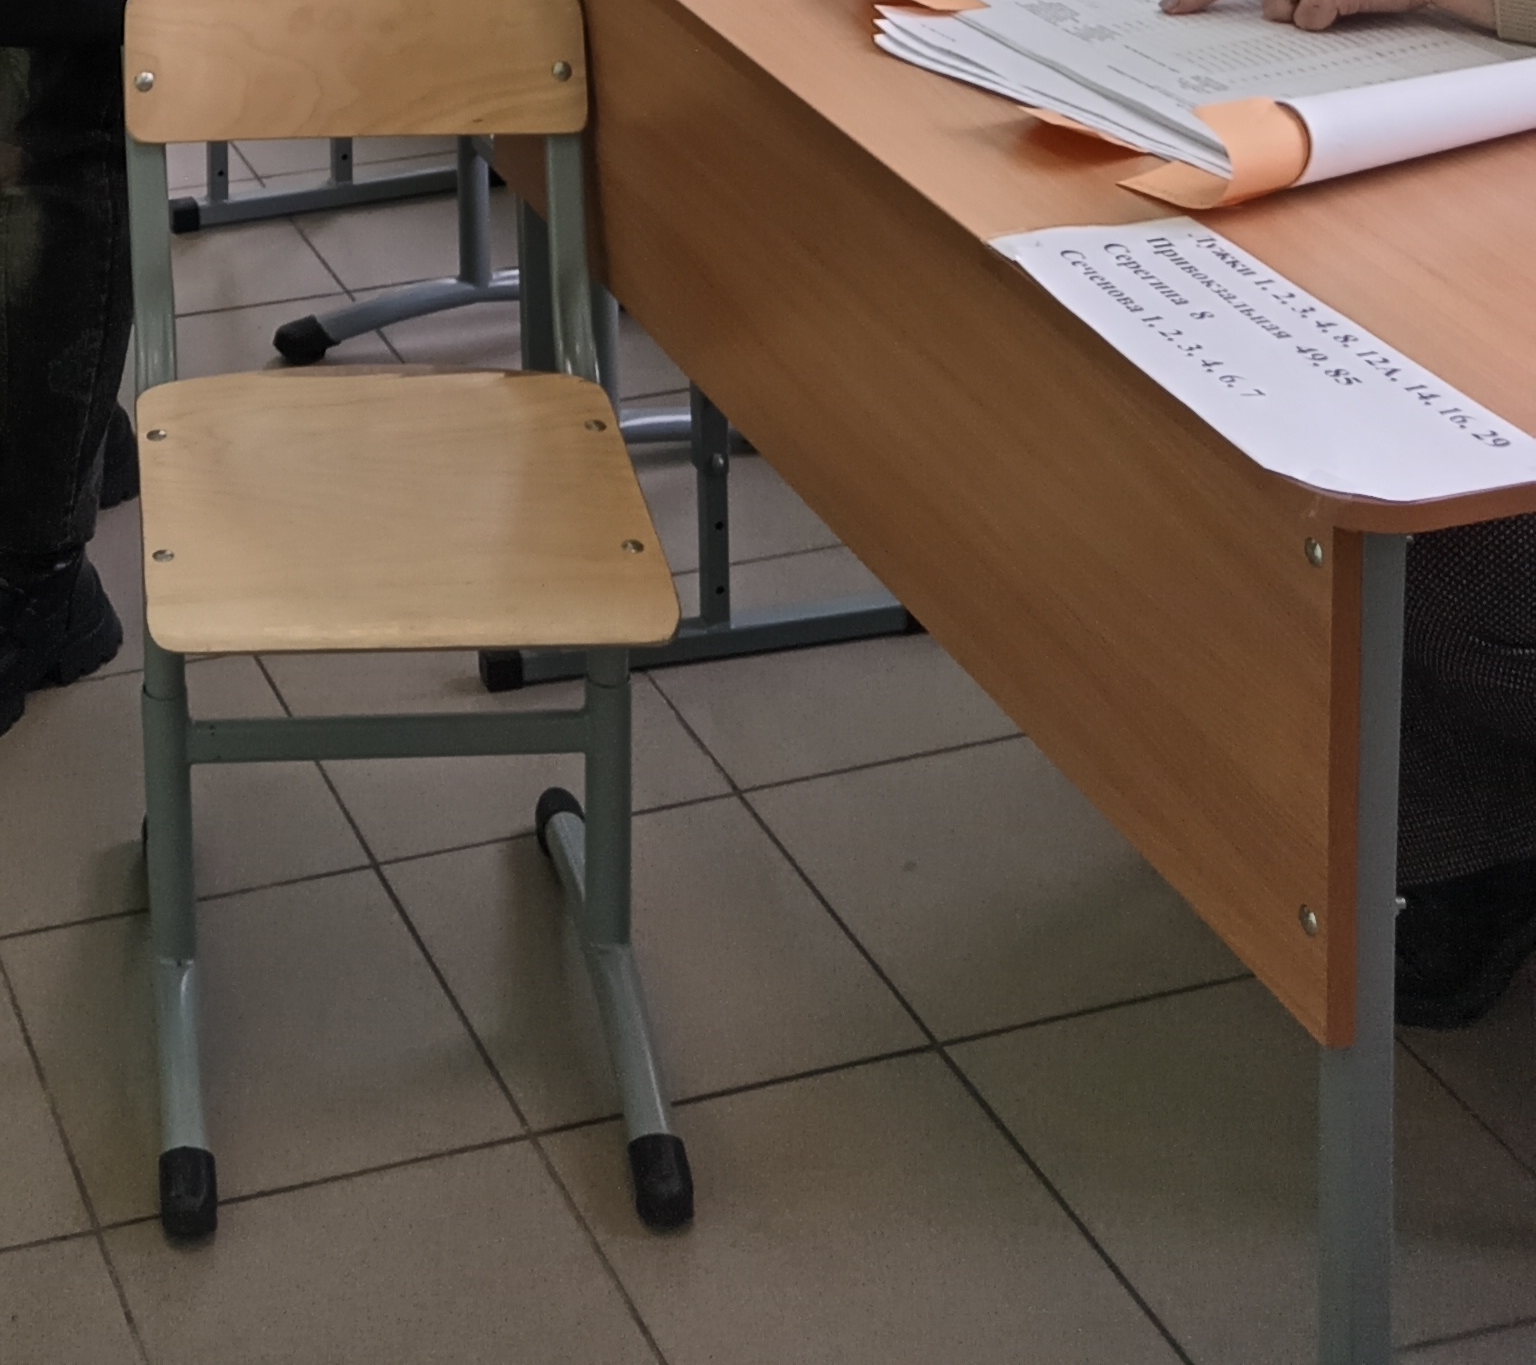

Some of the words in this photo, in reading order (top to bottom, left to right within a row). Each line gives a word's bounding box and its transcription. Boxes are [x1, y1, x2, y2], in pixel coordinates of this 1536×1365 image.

[1060, 249, 1145, 313] Сеченова
[1239, 388, 1267, 398] 7
[1103, 242, 1190, 306] Серегина
[1189, 310, 1215, 320] 8
[1146, 237, 1293, 339] Привокзальная
[1295, 345, 1329, 367] 49,
[1324, 368, 1363, 386] 85
[1187, 232, 1257, 277] Лужки
[1404, 384, 1442, 406] 14,
[1439, 407, 1475, 429] 16,
[1471, 429, 1511, 449] 29
